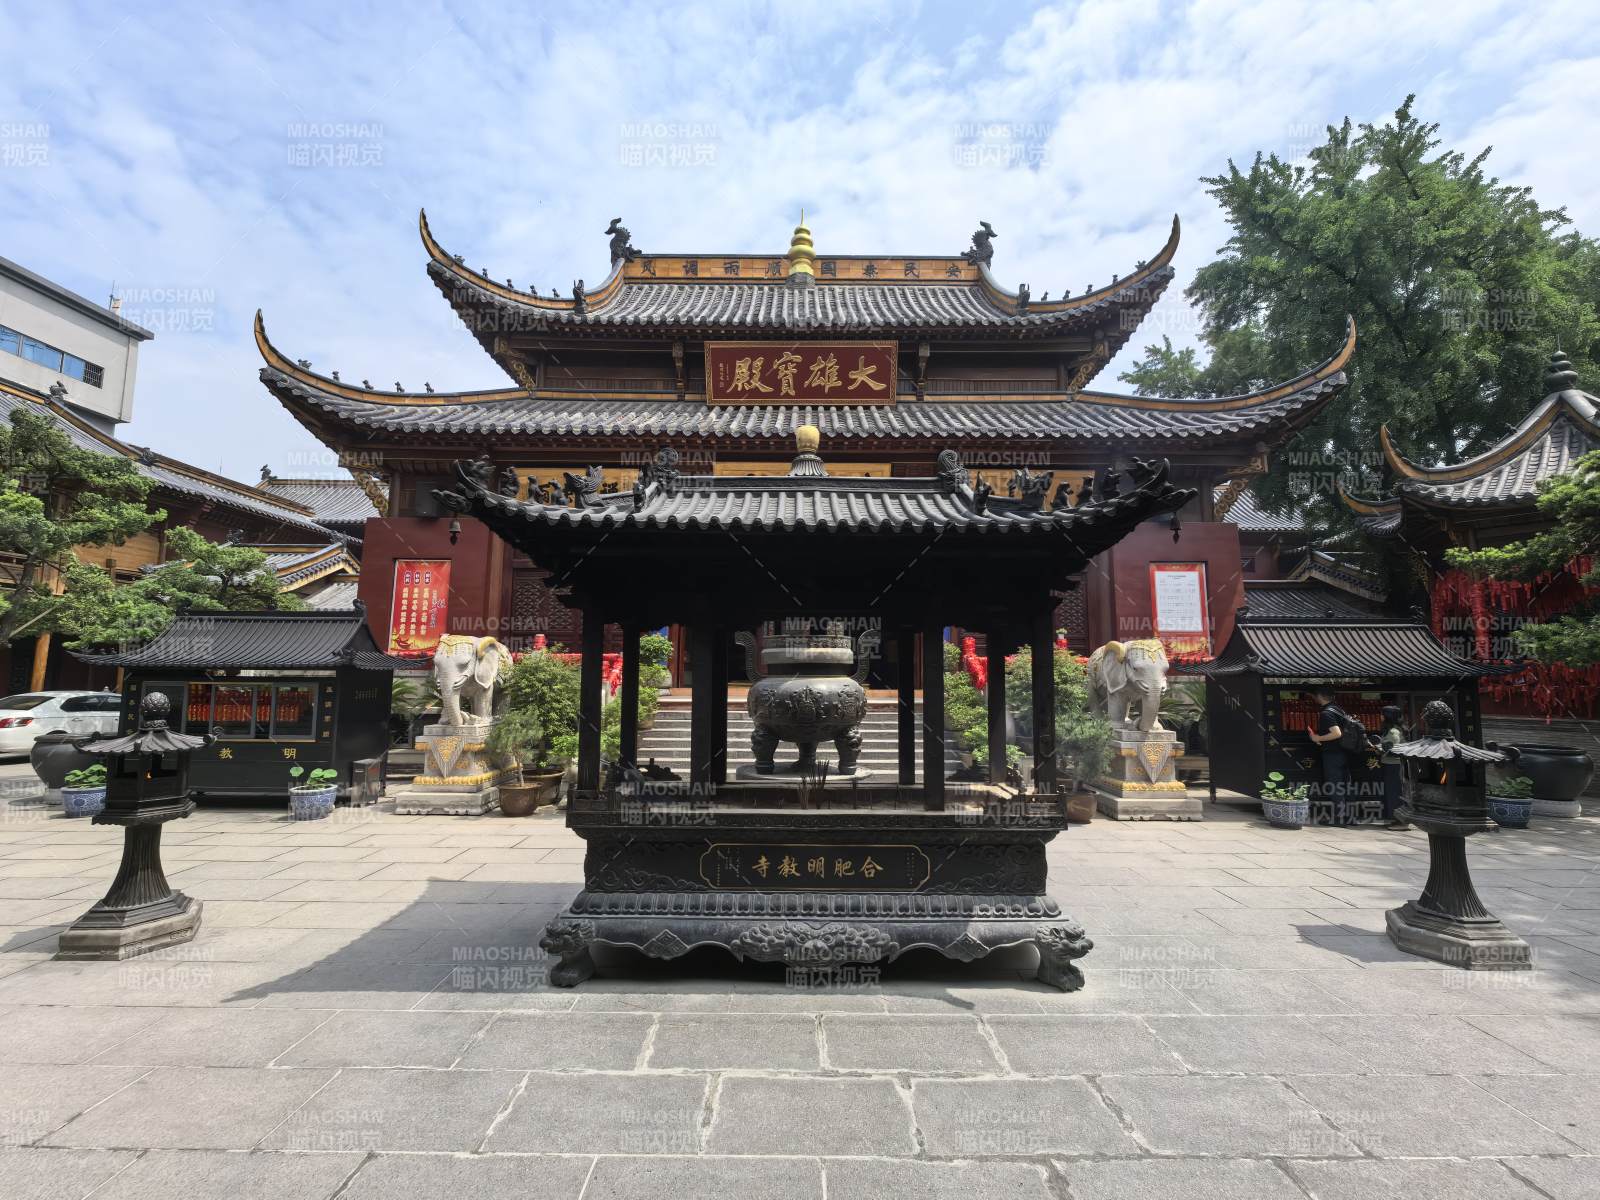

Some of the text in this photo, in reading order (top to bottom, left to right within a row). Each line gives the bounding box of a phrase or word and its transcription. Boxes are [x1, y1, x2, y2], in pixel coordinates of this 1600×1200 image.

[752, 855, 884, 879] 合肥明教寺
